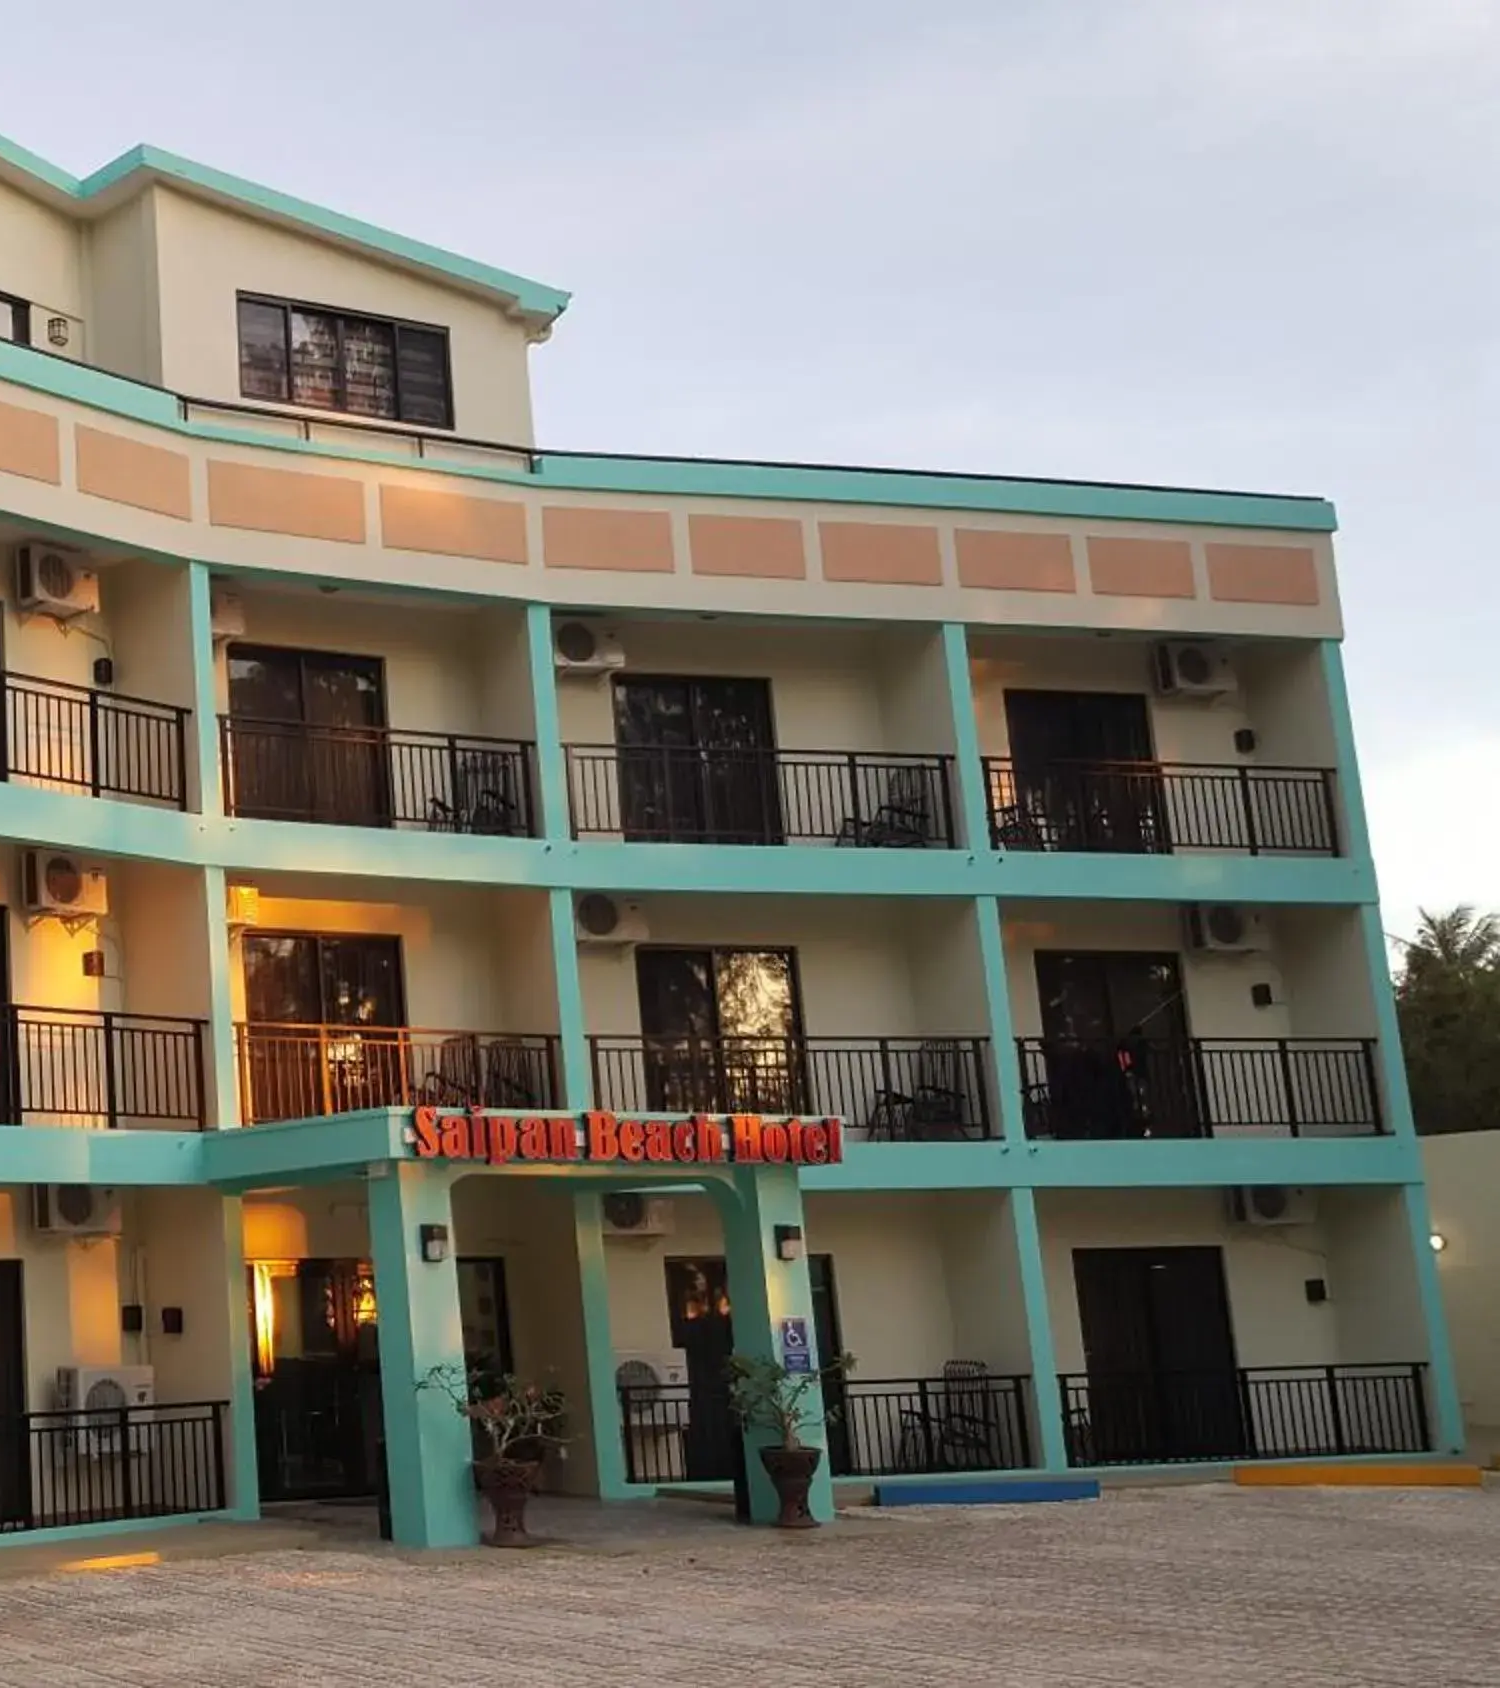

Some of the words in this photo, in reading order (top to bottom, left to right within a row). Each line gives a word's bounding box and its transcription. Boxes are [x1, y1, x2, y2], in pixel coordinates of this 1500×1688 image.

[414, 1105, 577, 1164] Saipan
[588, 1109, 725, 1163] Beach
[733, 1113, 842, 1163] Hotel
